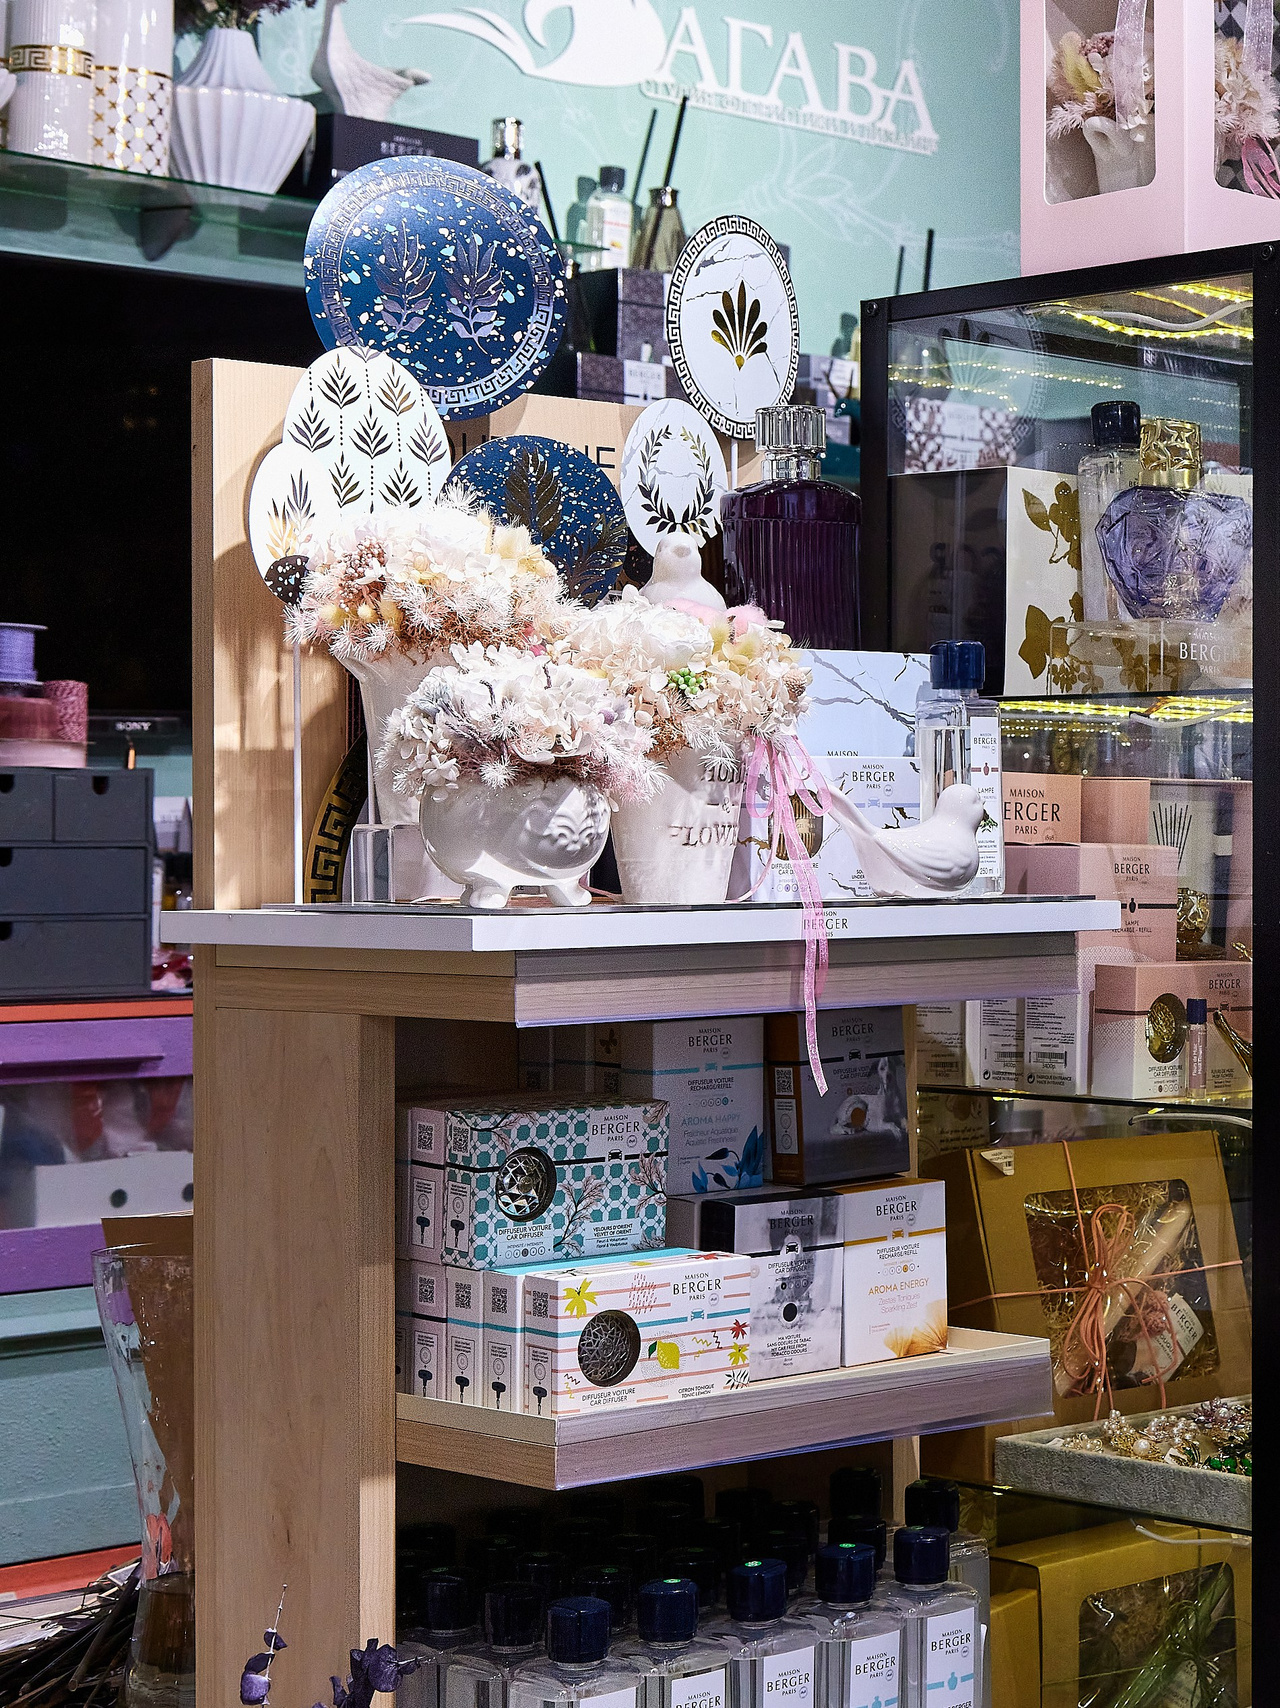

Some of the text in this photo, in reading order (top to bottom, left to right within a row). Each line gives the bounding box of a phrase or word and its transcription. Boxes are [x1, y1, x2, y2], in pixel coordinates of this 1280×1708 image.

[658, 7, 939, 140] АГАВА
[115, 721, 151, 731] SONY
[973, 737, 997, 745] BERGER
[852, 771, 895, 782] BERGER
[1009, 789, 1045, 798] MAISON
[1003, 801, 1061, 822] ERGER
[1014, 825, 1038, 835] PARIS
[1114, 863, 1150, 875] BERGER
[1208, 979, 1241, 990] BERGER
[831, 1023, 874, 1037] BERGER
[688, 1034, 733, 1047] BERGER
[690, 1083, 732, 1092] RECHARGE/REFILL
[681, 1116, 713, 1127] AROMA
[591, 1121, 640, 1136] BERGER
[876, 1200, 917, 1217] BERGER
[769, 1215, 814, 1230] BERGER
[499, 1223, 552, 1235] DIFFUSEUR VOITURE
[518, 1231, 544, 1239] DIFFUSER
[876, 1242, 920, 1255] DIFFUSEUR VOITURE
[879, 1249, 918, 1260] RECHARGE/REFILL
[768, 1261, 794, 1270] DIFFUSEUR
[684, 1272, 709, 1280] MAISON
[673, 1278, 722, 1296] BERGER
[868, 1277, 930, 1296] AROMA ENERGY
[689, 1293, 706, 1301] PARIS
[1171, 1303, 1198, 1340] BERGER
[695, 1383, 715, 1391] TONIQUE
[581, 1387, 636, 1402] DIFFUSEUR VOITURE
[602, 1395, 628, 1405] DIFFUSER
[942, 1629, 963, 1638] MAISON
[930, 1632, 972, 1652] BERGER
[866, 1652, 888, 1661] MAISON
[945, 1648, 960, 1656] PARIS
[855, 1656, 896, 1676] BERGER
[778, 1668, 801, 1677] MAISON
[869, 1671, 884, 1679] PARIS
[766, 1672, 811, 1692] BERGER
[687, 1691, 711, 1700] MAISON
[781, 1688, 797, 1696] PARIS
